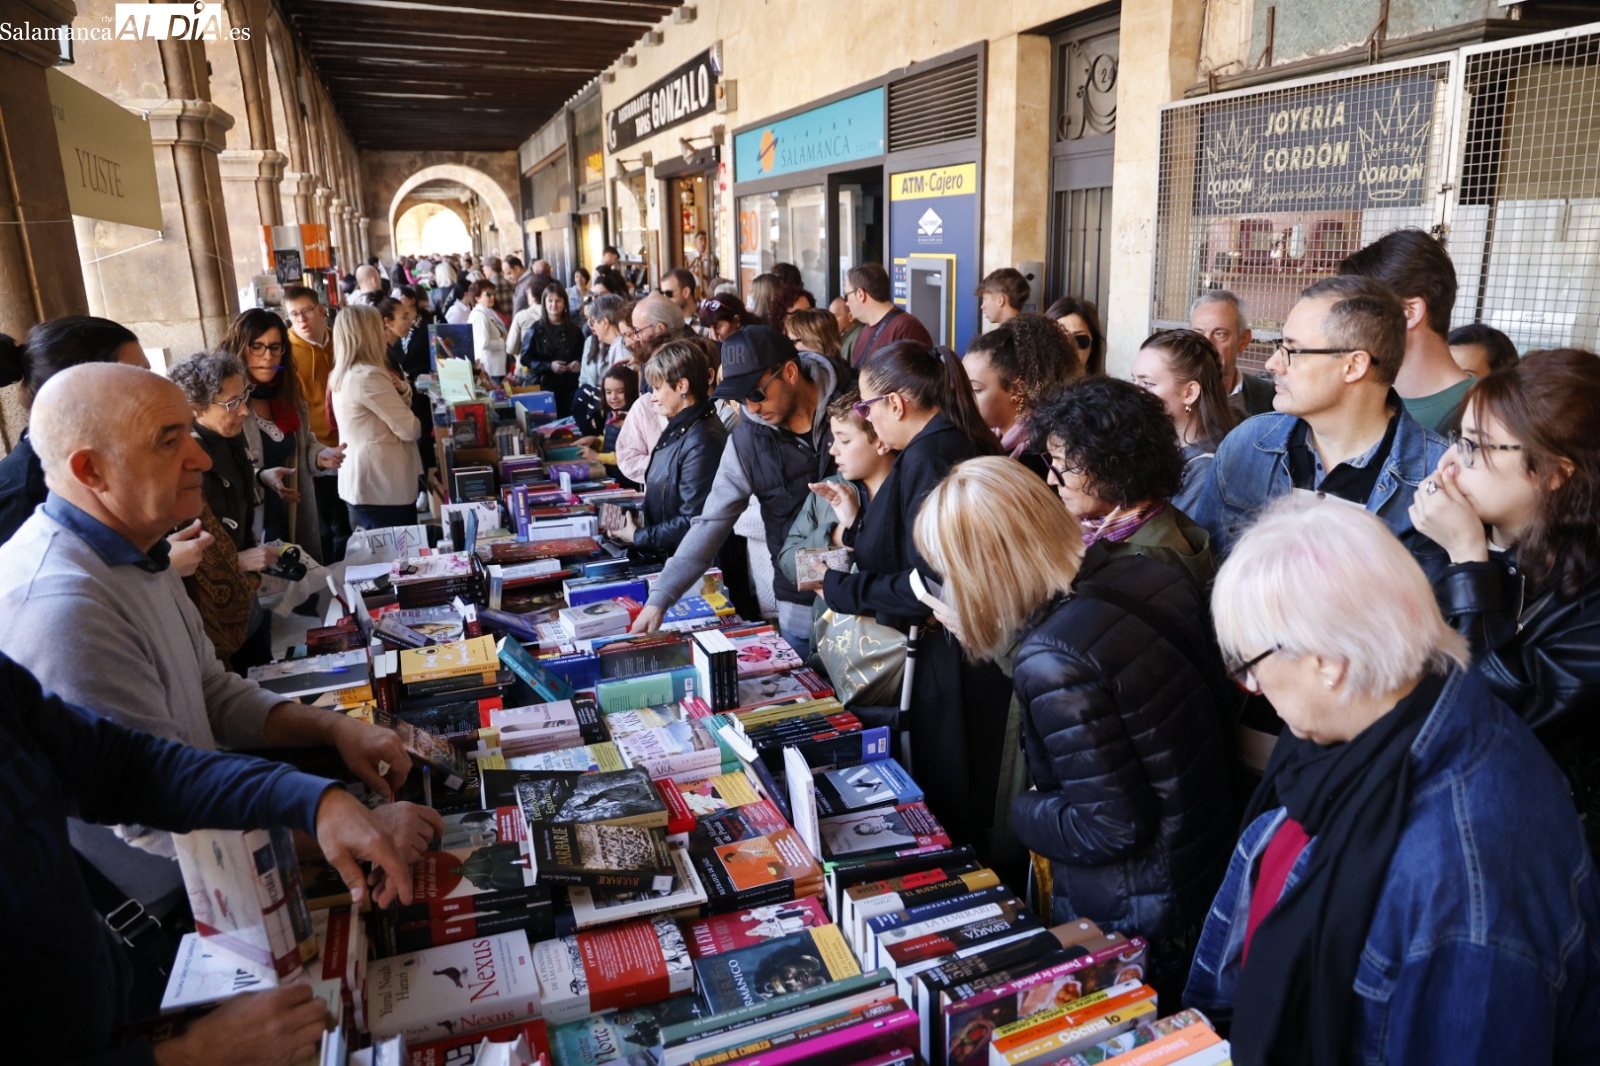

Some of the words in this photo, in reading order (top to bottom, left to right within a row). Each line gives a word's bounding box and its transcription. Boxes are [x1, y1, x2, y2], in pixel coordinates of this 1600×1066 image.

[652, 64, 709, 129] GONZALO
[635, 112, 651, 137] TAPAS
[1264, 96, 1346, 137] JOYERÍA
[781, 135, 851, 168] SALAMANCA
[1263, 136, 1350, 173] CORDÓN
[75, 148, 124, 198] YUSTE
[902, 175, 925, 194] ATM
[929, 170, 963, 195] Cajero
[651, 764, 675, 776] ARK
[552, 827, 573, 866] BARBARIE
[598, 875, 640, 886] BARBARIE
[916, 885, 938, 896] BUEN
[911, 900, 951, 914] PETERSON
[938, 904, 999, 925] TEMERARIA
[692, 922, 714, 945] EYRE
[963, 920, 1012, 941] ESPARTA
[378, 964, 391, 991] Noah
[468, 939, 499, 1003] Nexus
[396, 971, 410, 1001] Harari
[379, 990, 393, 1018] Yuval
[460, 1009, 515, 1030] Nexus
